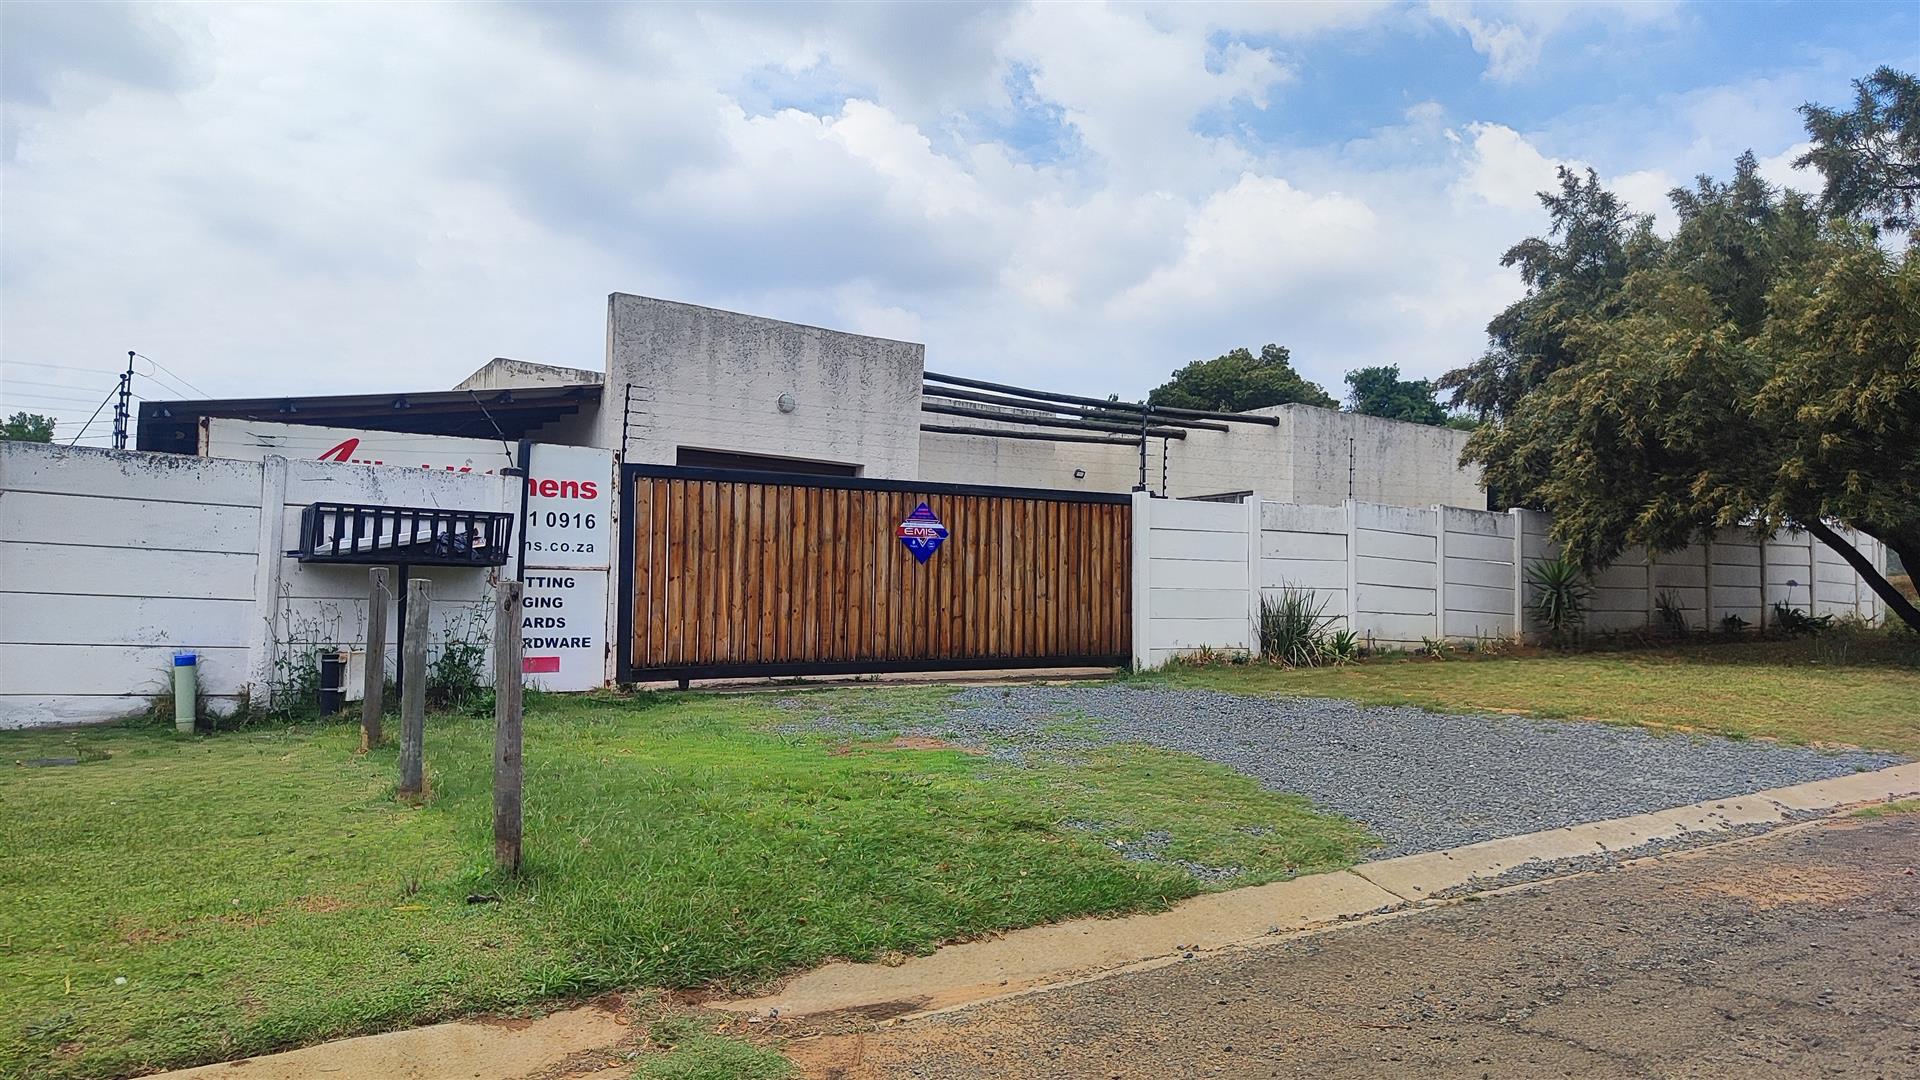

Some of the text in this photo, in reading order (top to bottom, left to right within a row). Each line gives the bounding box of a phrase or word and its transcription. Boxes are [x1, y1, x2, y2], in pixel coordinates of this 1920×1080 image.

[529, 510, 596, 530] 1 0916
[904, 527, 937, 536] EMIS
[525, 576, 575, 589] TTING
[522, 596, 563, 609] GING
[522, 616, 566, 629] ARDS
